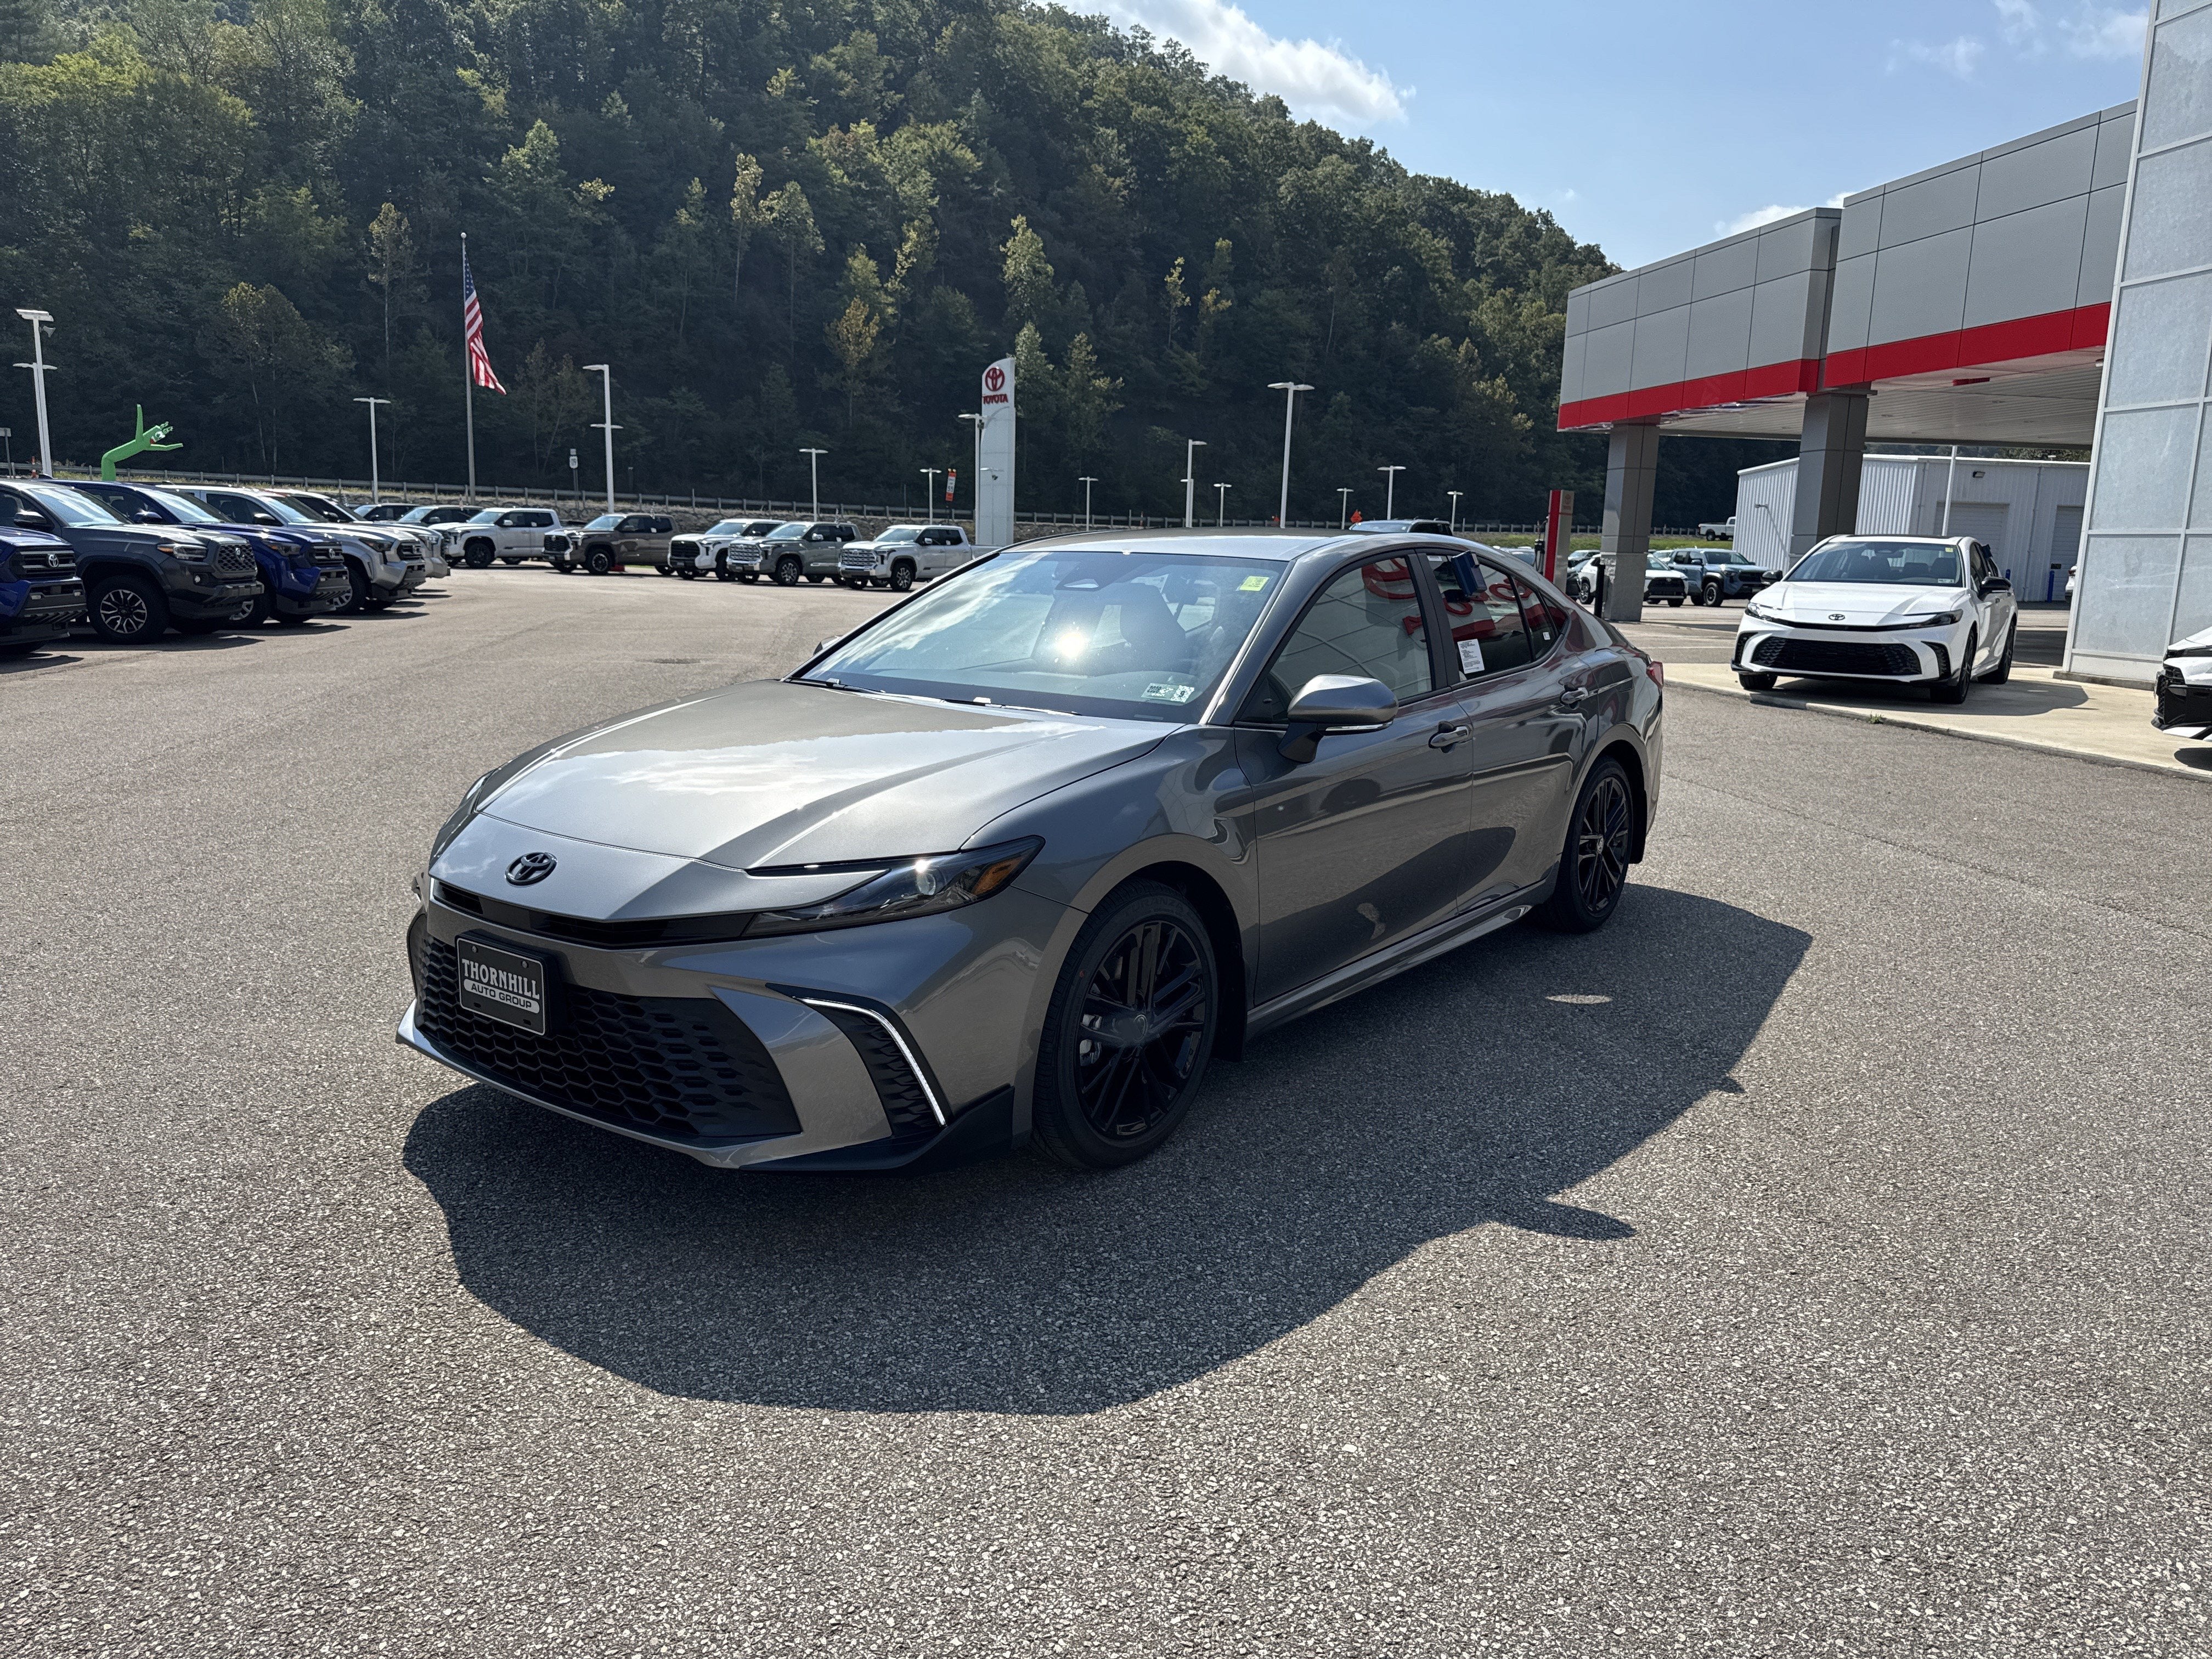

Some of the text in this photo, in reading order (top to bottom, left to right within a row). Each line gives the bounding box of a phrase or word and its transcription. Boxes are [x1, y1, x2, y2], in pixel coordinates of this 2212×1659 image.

[983, 394, 1008, 404] TOYOTA
[462, 958, 540, 1000] THORNHILL
[471, 983, 532, 1008] AUTO GROUP
